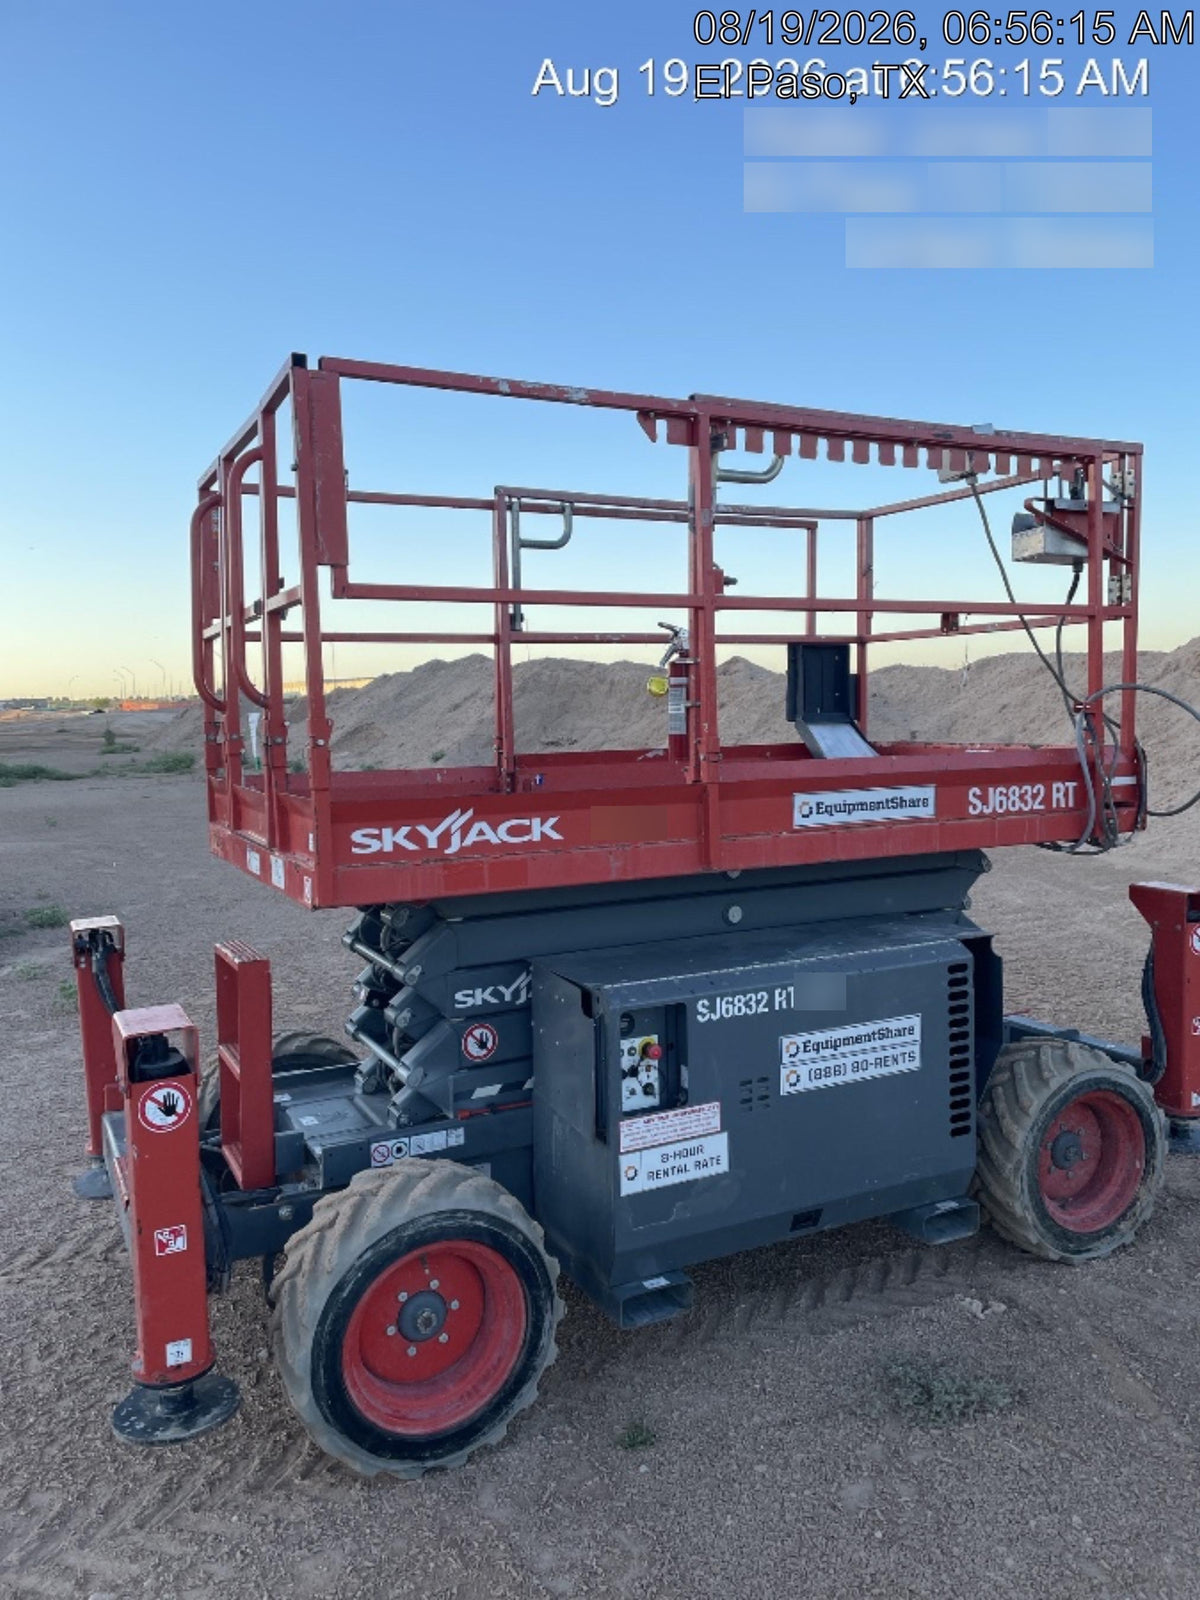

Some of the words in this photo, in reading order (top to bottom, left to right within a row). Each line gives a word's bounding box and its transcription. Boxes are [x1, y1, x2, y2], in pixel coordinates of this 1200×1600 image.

[815, 796, 930, 817] EquipmentShare
[967, 783, 1046, 816] SJ6832
[1051, 782, 1078, 808] RT
[351, 808, 564, 854] SKYJACK
[454, 971, 533, 1009] SKYJ
[696, 991, 769, 1023] SJ6832
[801, 1025, 916, 1055] EquipmentShare
[647, 1163, 691, 1181] RENTAL
[694, 1155, 722, 1171] RATE
[660, 1144, 705, 1164] 8-HOUR
